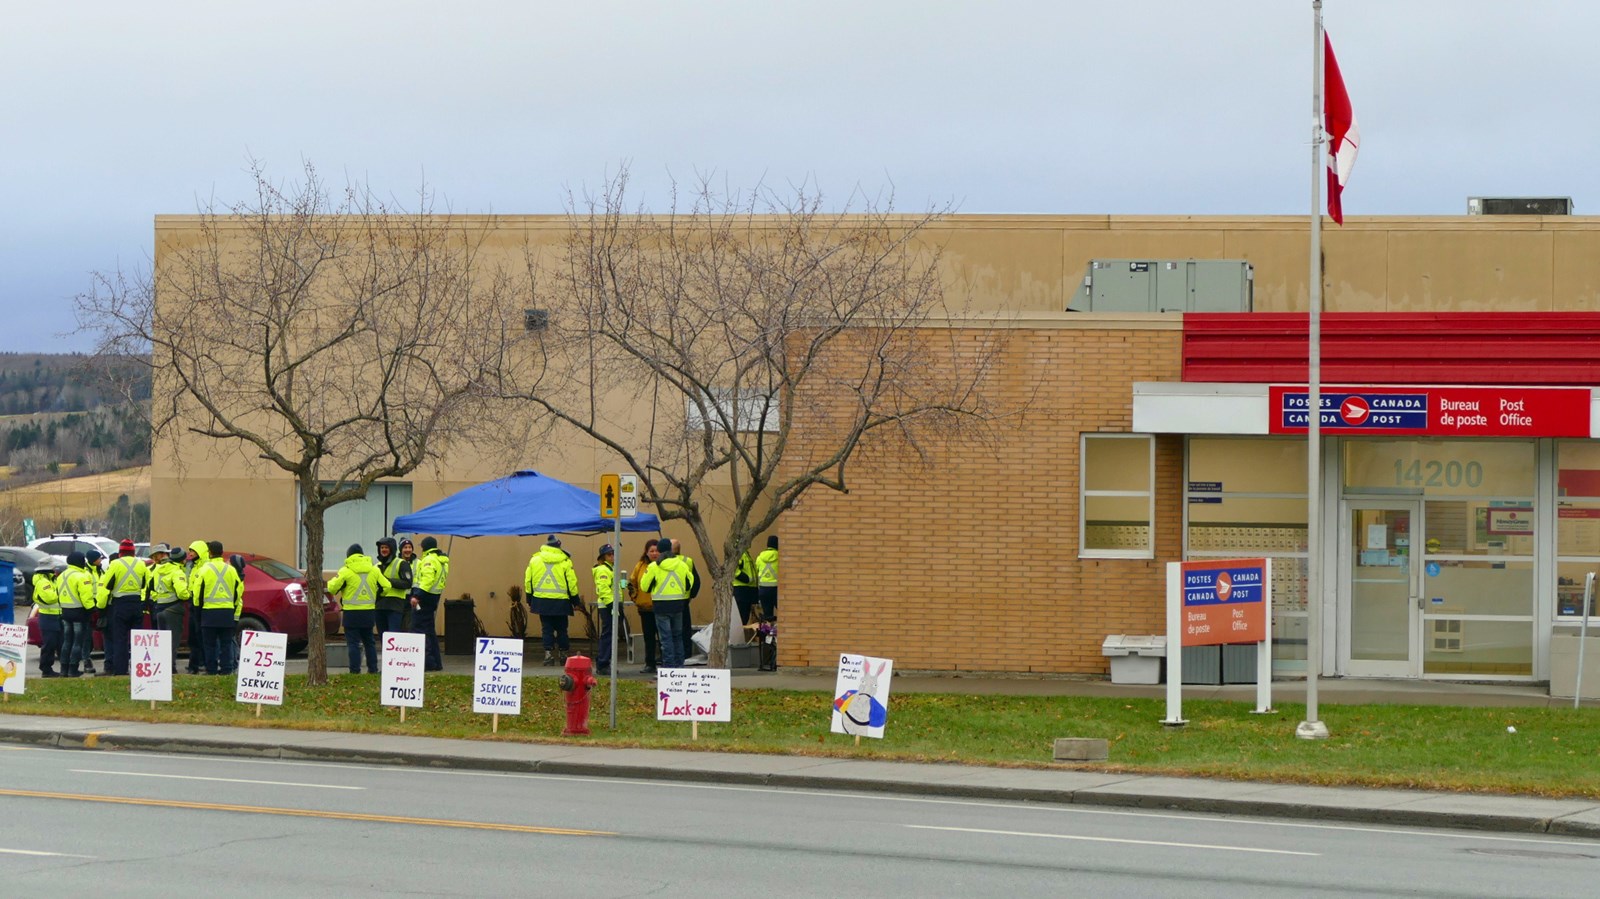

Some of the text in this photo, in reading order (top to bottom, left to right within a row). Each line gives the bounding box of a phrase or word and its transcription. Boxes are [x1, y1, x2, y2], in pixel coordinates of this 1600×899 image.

[1289, 398, 1421, 408] POSES CANADA
[1440, 398, 1480, 411] Bureau
[1500, 398, 1524, 411] Post
[1289, 414, 1402, 424] CANDA POST
[1440, 413, 1487, 429] de poste
[1500, 413, 1532, 426] Office
[1394, 459, 1483, 488] 14200
[1187, 573, 1259, 584] POSTES CANADA
[1187, 590, 1249, 601] CANADA POST
[1187, 612, 1207, 622] Bureau
[1232, 609, 1244, 618] Post
[1187, 624, 1210, 636] de poste
[1232, 621, 1248, 631] Office
[134, 632, 159, 647] PAYÉ
[386, 637, 419, 653] Sécurité
[255, 651, 273, 667] 25
[492, 656, 509, 672] 25
[135, 662, 161, 678] 85%
[241, 678, 279, 690] SERVICE
[480, 683, 517, 695] SERVICE
[662, 698, 717, 716] Lock-out
